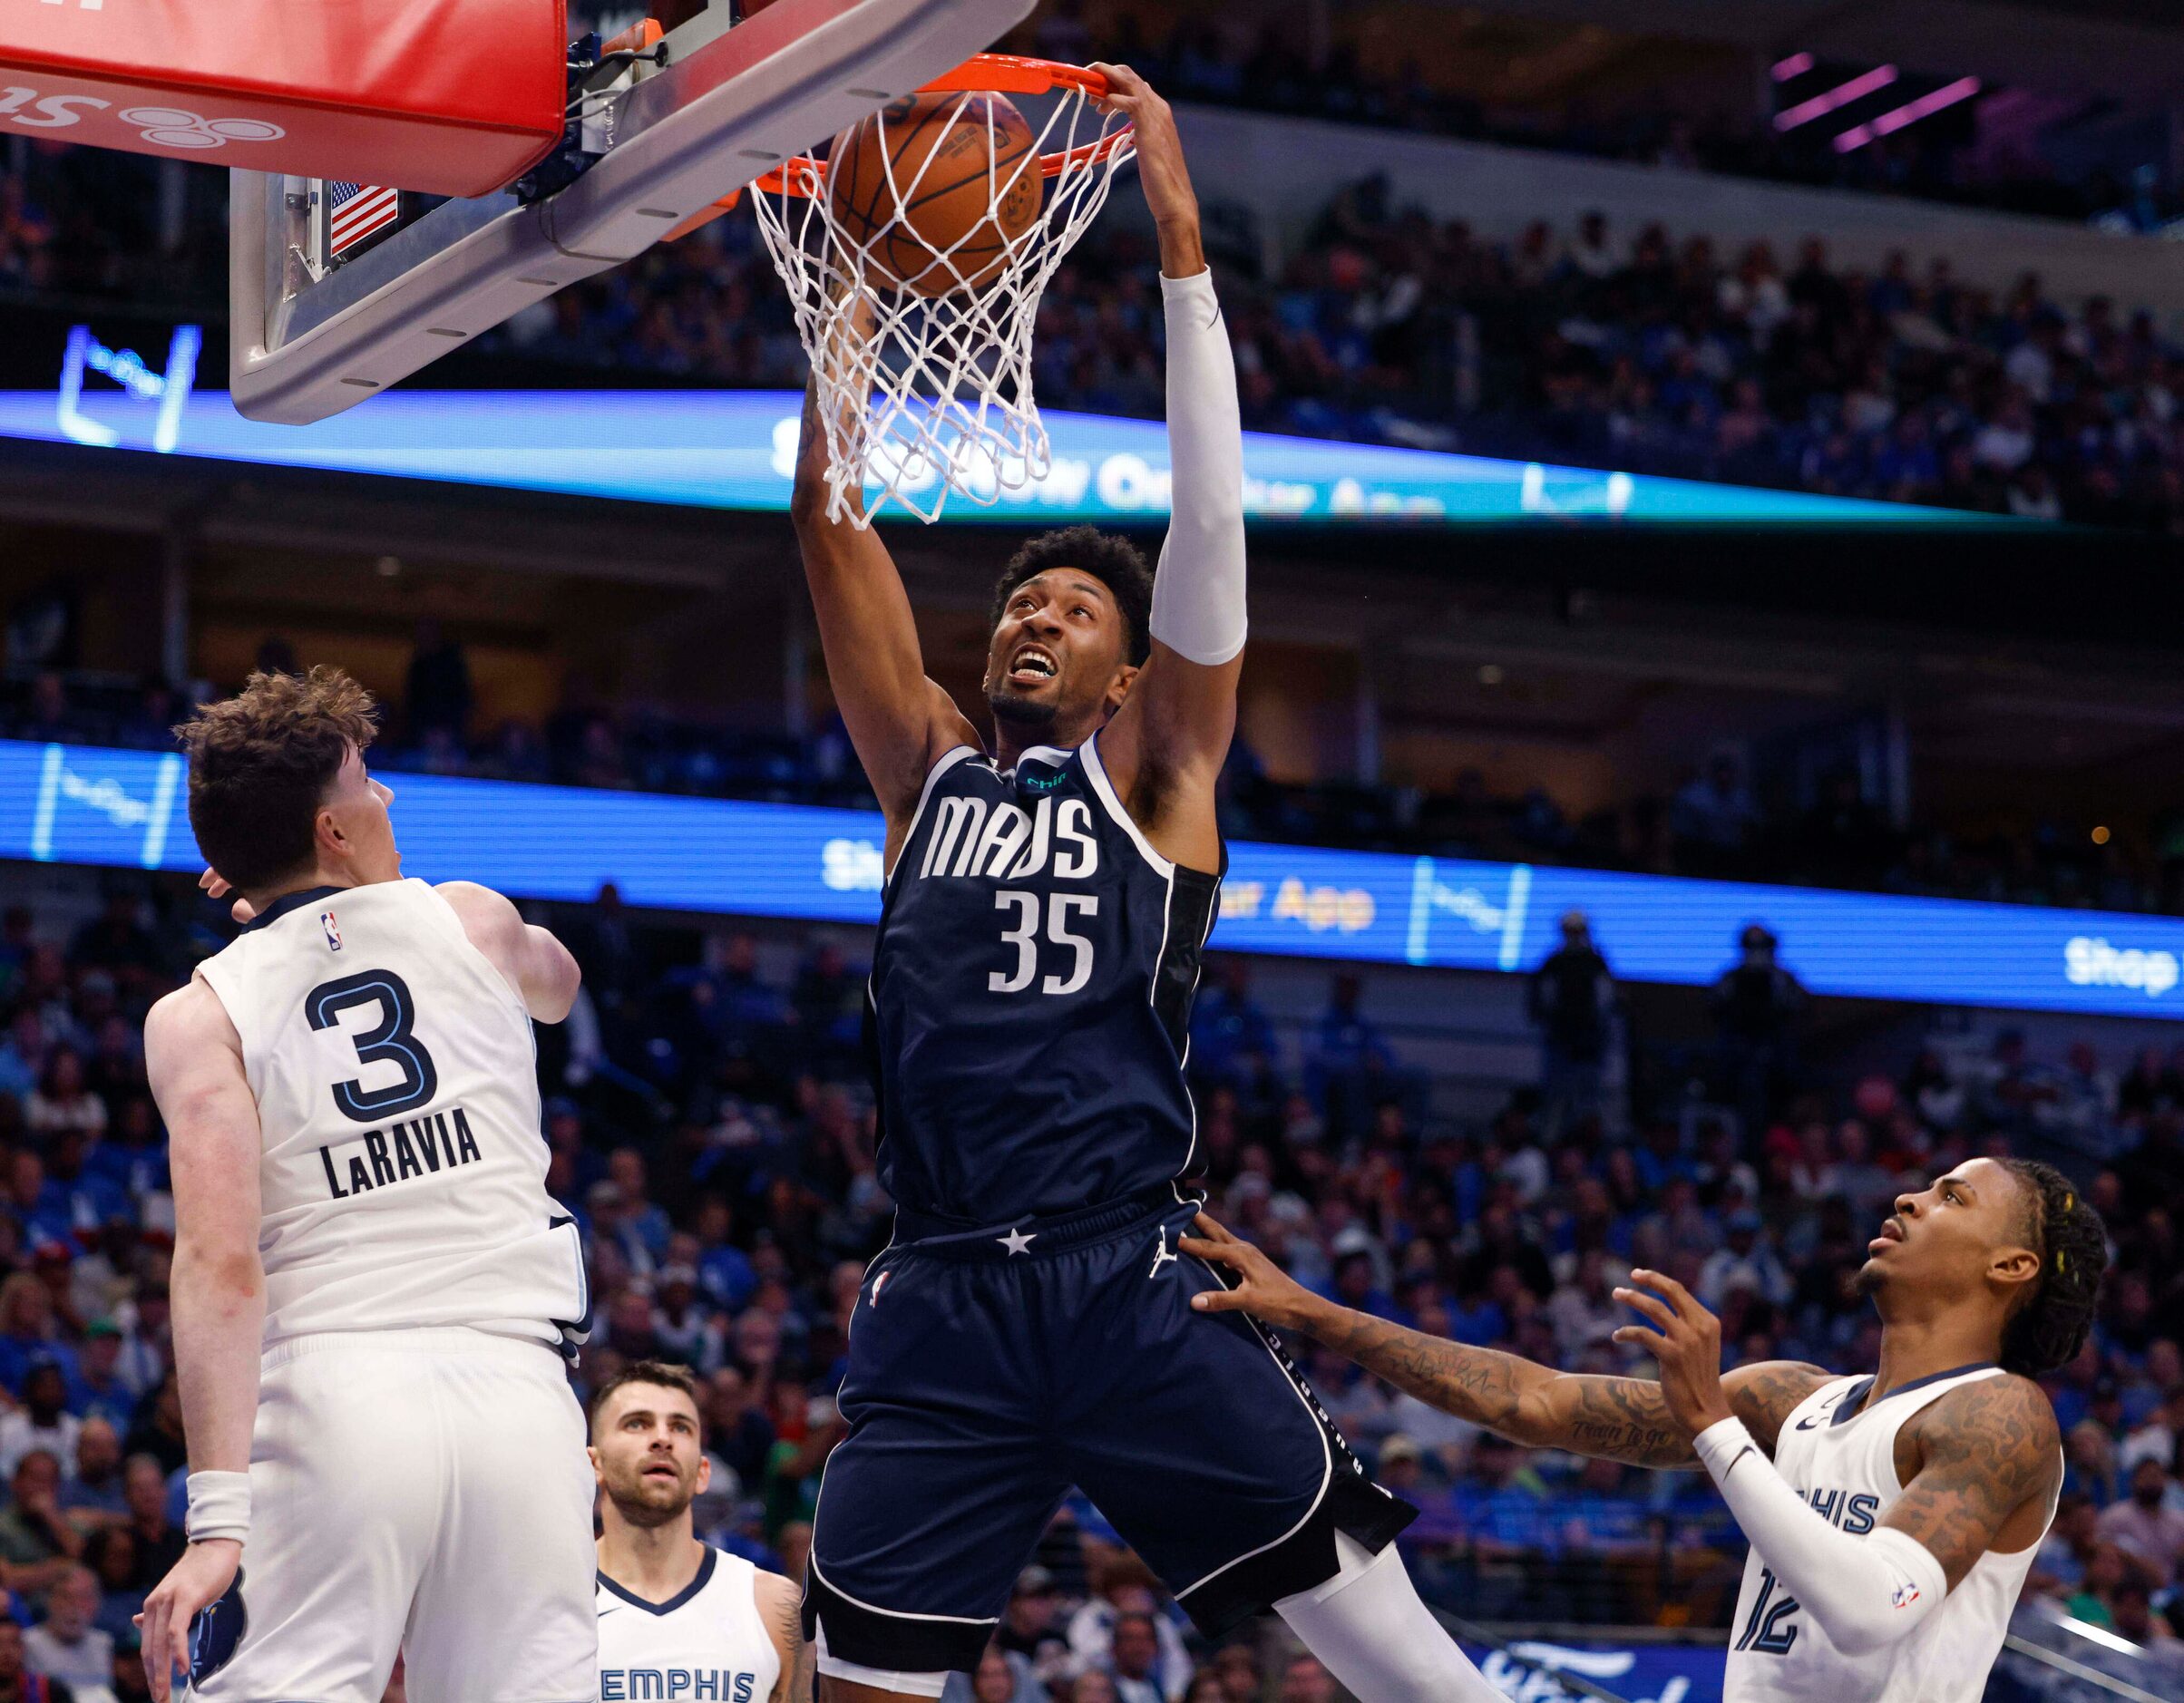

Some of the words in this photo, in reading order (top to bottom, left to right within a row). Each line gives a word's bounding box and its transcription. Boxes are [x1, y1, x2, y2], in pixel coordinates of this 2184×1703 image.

[989, 890, 1099, 995] 35
[1272, 876, 1376, 936] App
[2063, 936, 2179, 998] Shop
[305, 968, 438, 1123] 3
[1734, 1568, 1800, 1655] 12
[600, 1669, 755, 1703] EMPHIS
